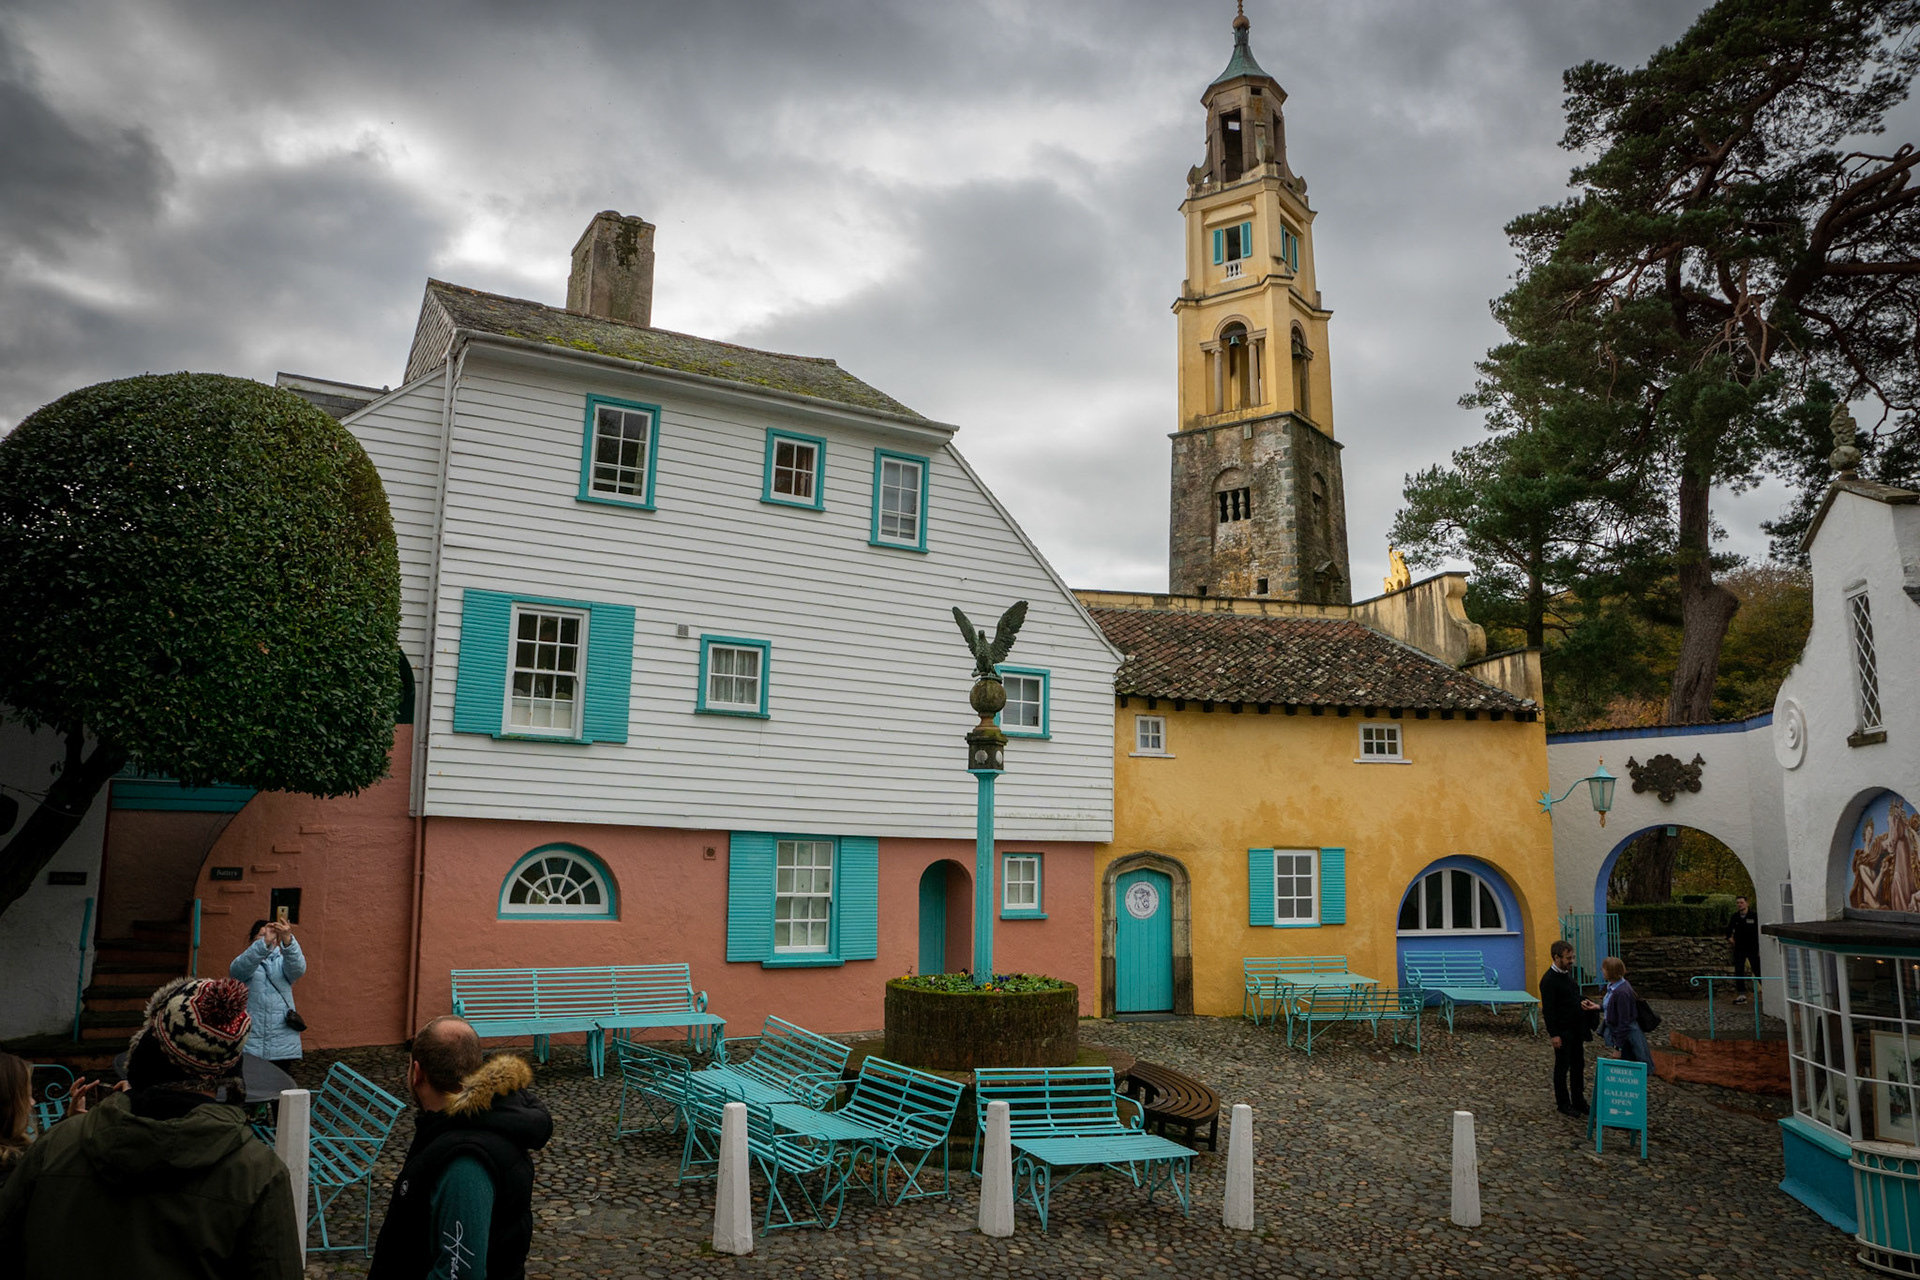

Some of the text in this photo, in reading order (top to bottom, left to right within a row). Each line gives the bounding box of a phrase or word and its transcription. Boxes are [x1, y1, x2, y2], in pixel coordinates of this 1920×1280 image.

[1610, 1067, 1633, 1076] ORIEL
[1617, 1077, 1639, 1085] AGOR
[1604, 1089, 1639, 1099] GALLERY
